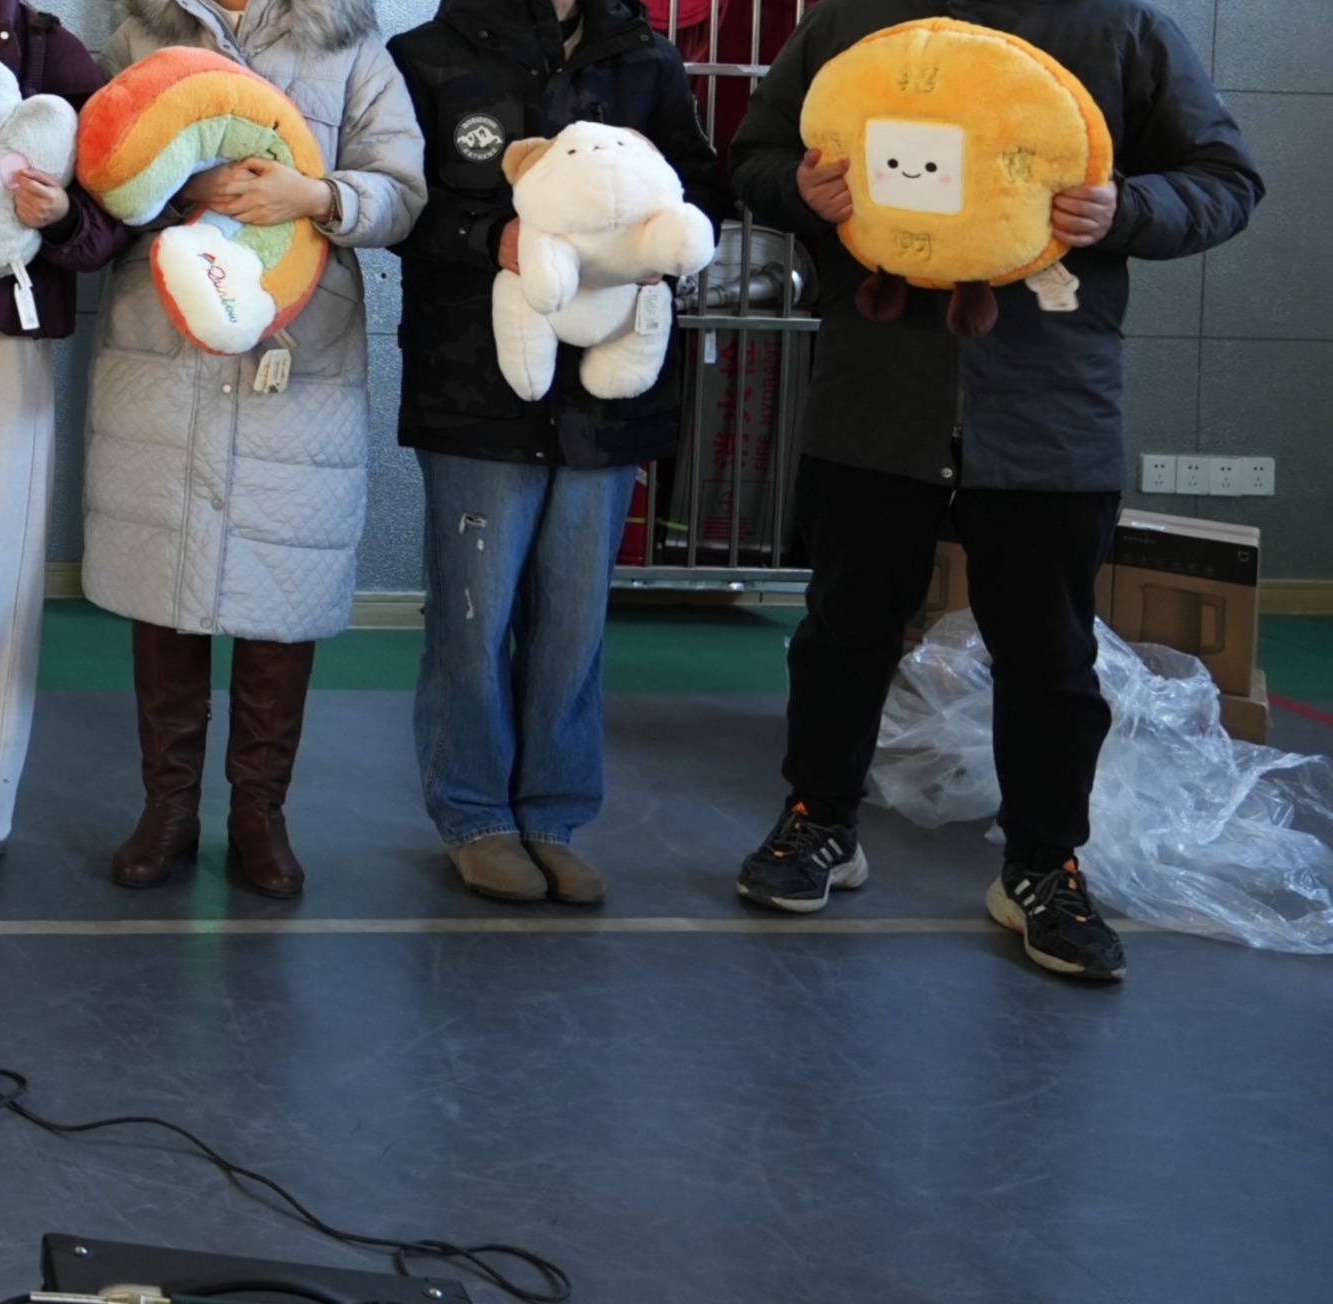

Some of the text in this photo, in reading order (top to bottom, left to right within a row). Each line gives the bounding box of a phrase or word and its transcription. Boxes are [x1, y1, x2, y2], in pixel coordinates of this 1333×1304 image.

[463, 148, 497, 160] EXTREME
[206, 264, 238, 324] Rainbow
[711, 341, 756, 470] 消火栓
[754, 339, 778, 474] FIRE HYDRANT
